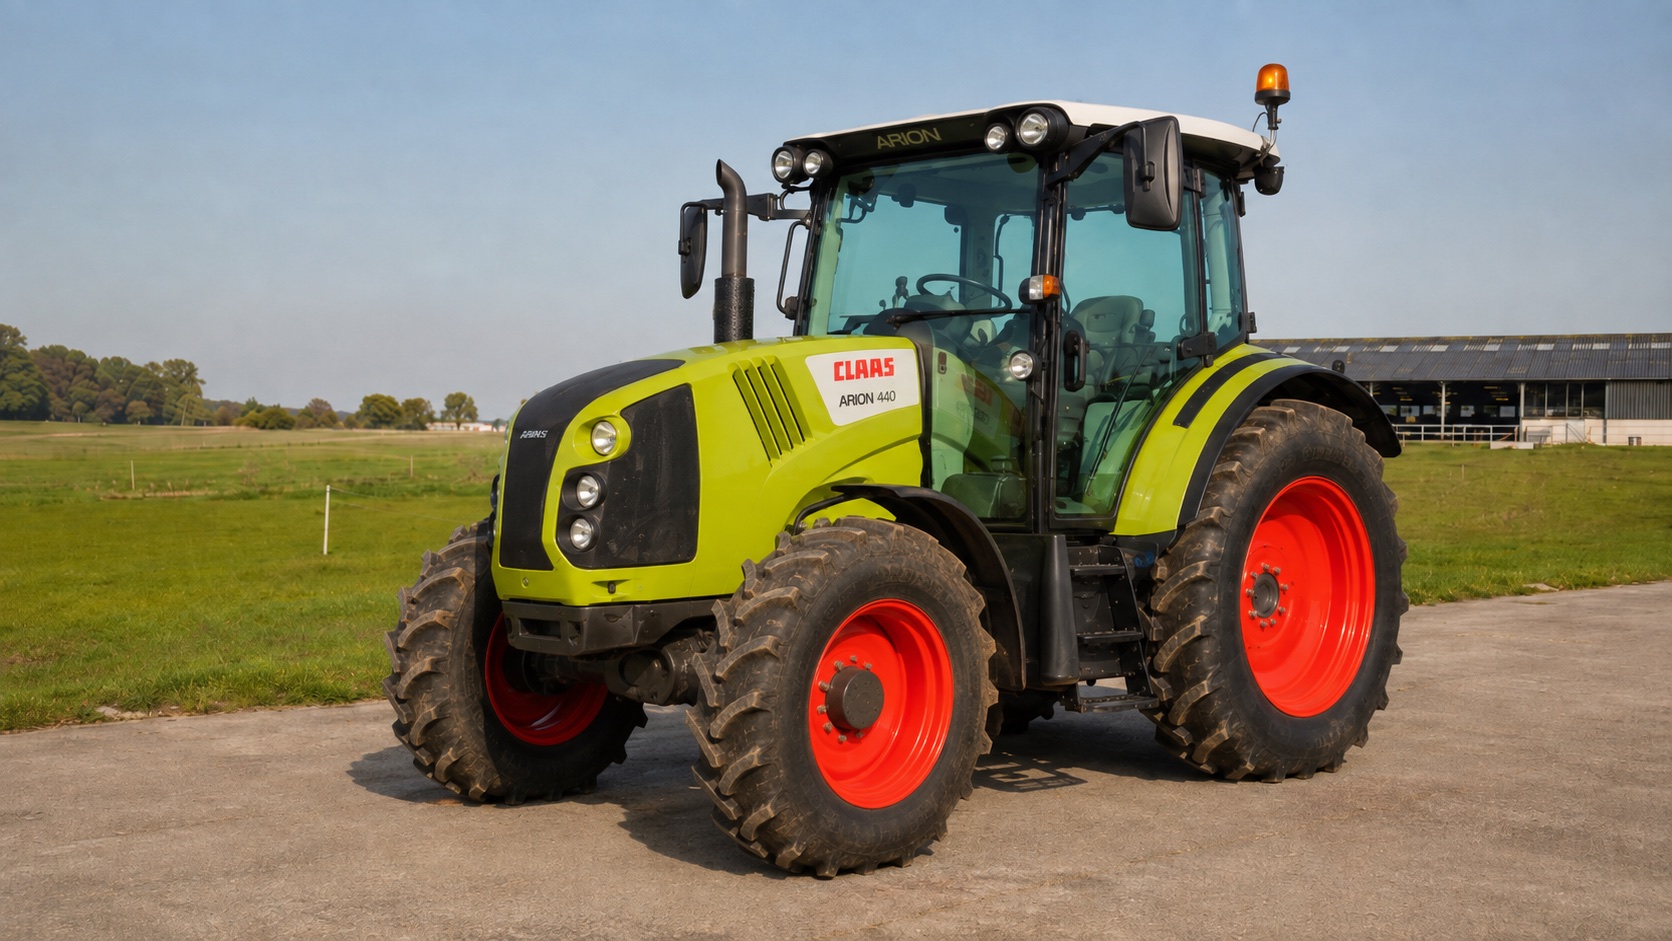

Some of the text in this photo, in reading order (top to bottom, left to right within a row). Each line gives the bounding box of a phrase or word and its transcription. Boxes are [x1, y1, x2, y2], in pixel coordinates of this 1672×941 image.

[877, 127, 942, 150] ARION
[833, 357, 895, 382] CLAAS
[839, 390, 897, 408] ARION 440
